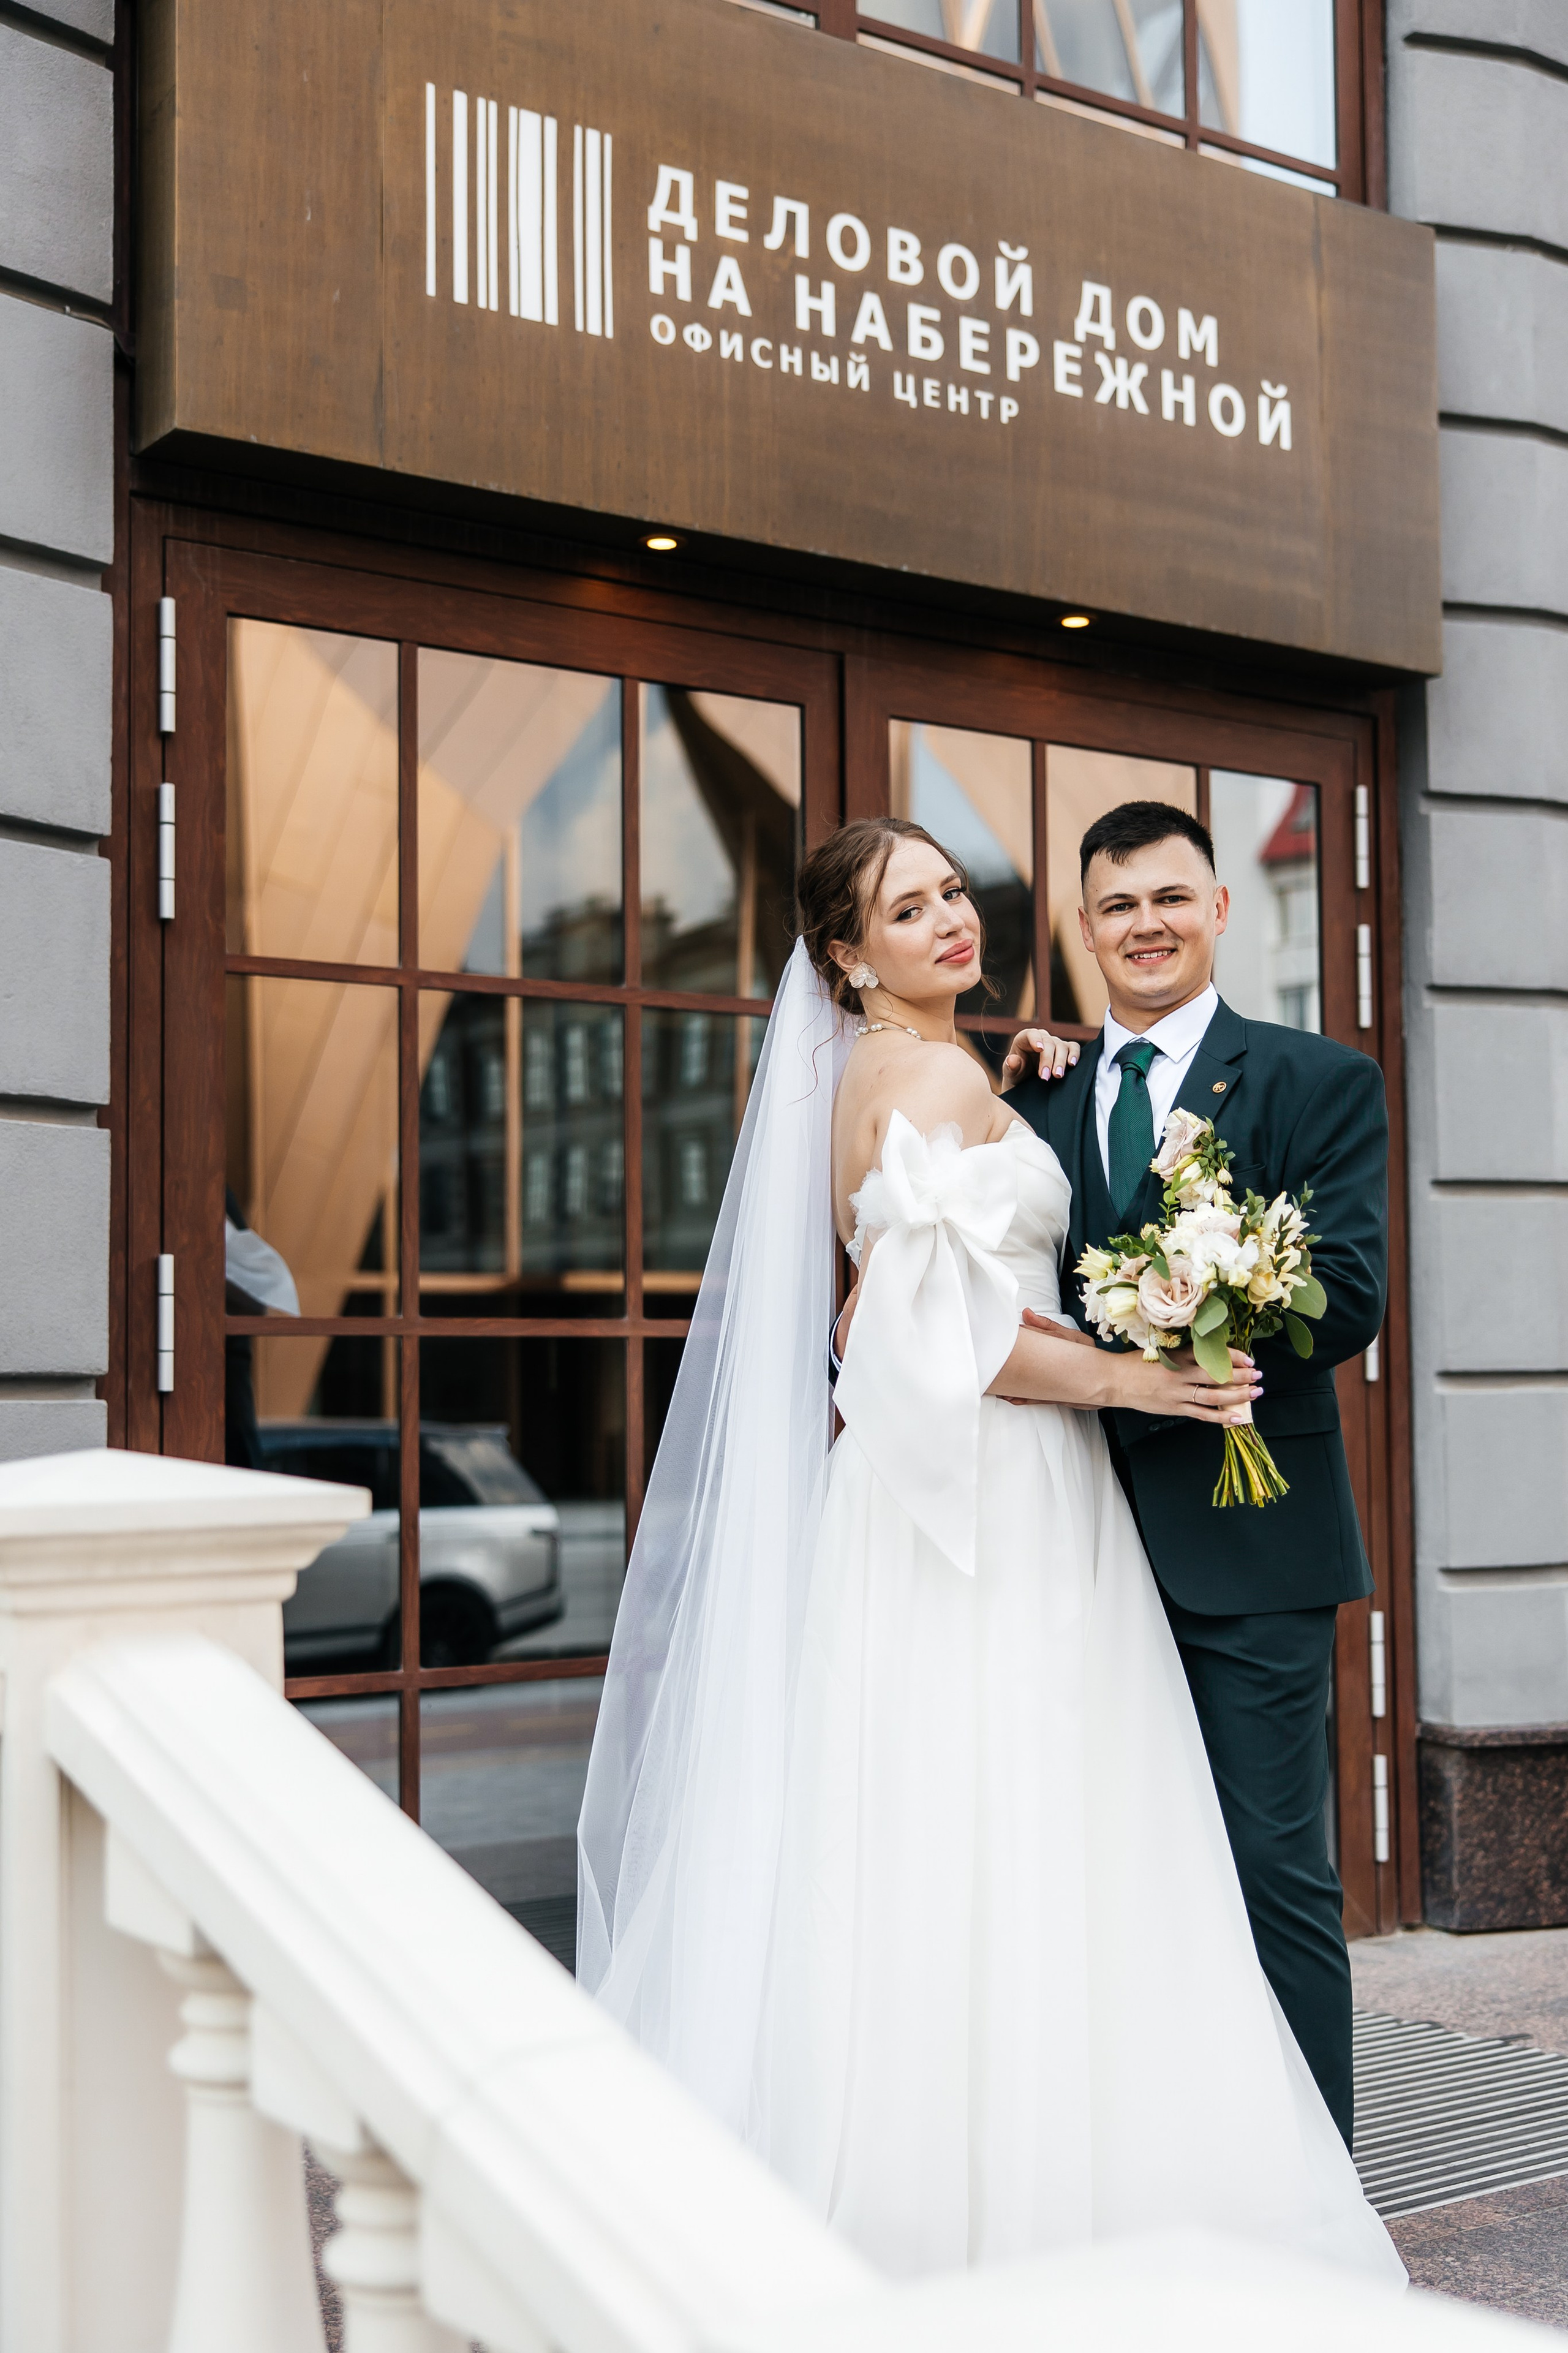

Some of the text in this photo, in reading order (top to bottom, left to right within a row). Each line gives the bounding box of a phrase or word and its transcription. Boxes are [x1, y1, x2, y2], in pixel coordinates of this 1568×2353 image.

[647, 163, 1219, 368] ДЕЛОВОЙ ДОМ
[647, 236, 1292, 451] НА НАБЕРЕЖНОЙ
[649, 313, 1020, 425] ОФИСНЫЙ ЦЕНТР
